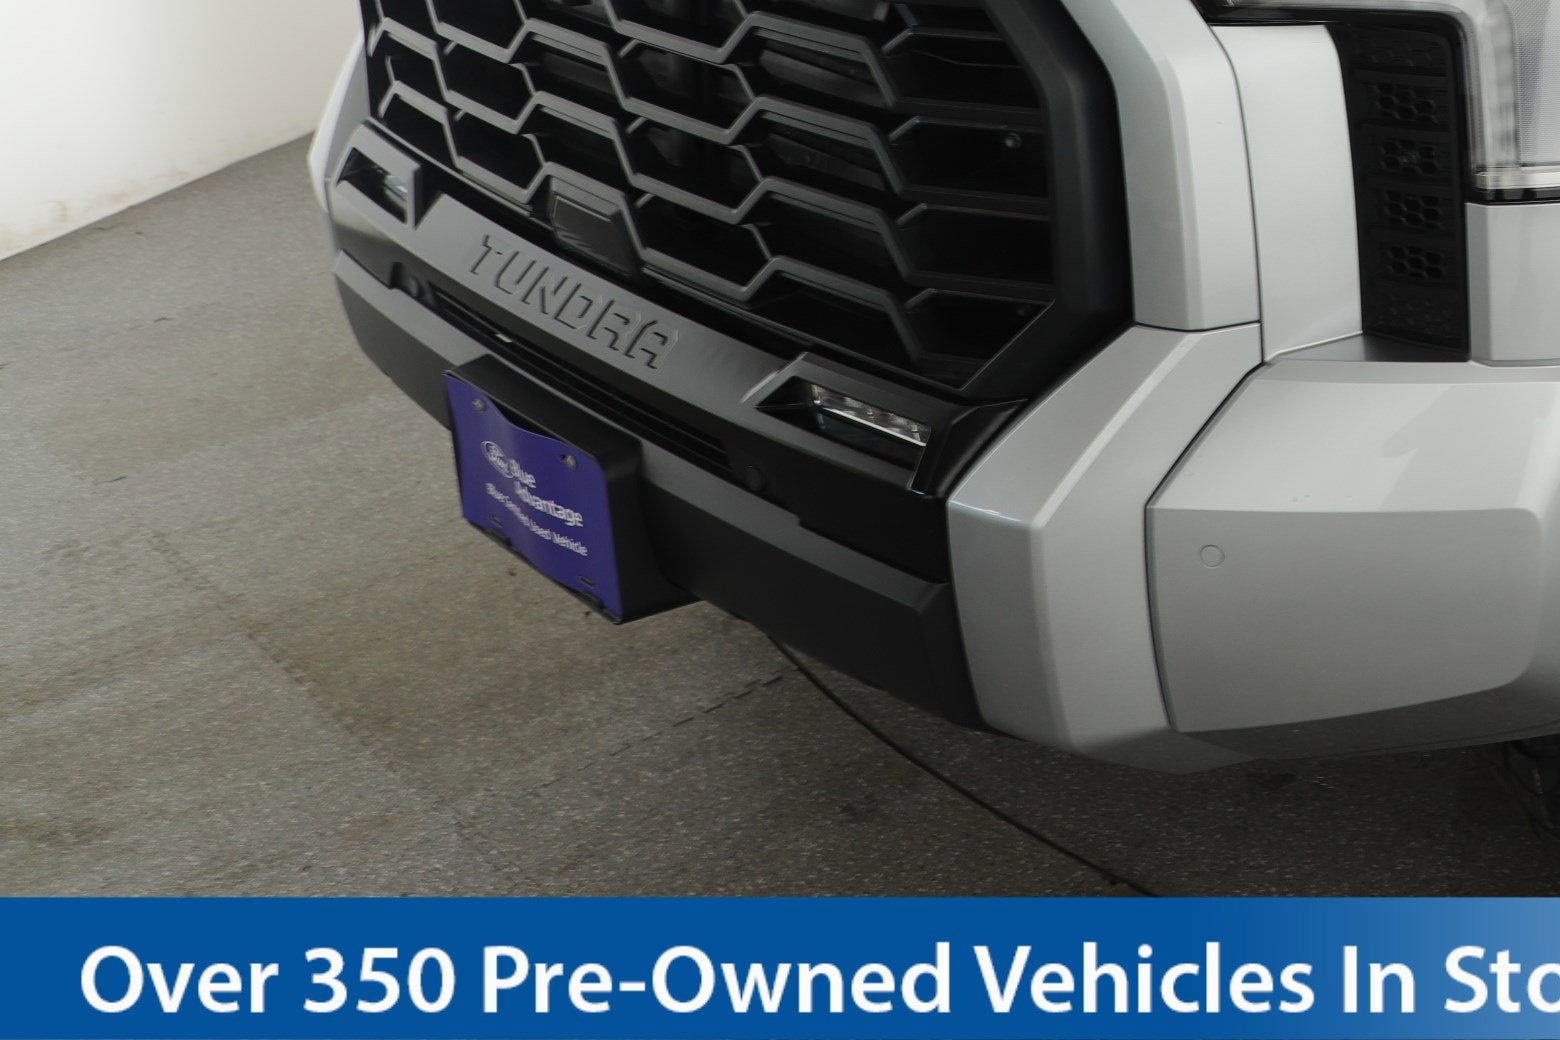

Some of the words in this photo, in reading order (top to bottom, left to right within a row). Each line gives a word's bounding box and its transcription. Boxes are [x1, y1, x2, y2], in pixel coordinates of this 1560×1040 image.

[468, 234, 679, 369] TUNDRA
[508, 458, 537, 489] Blue
[513, 480, 584, 527] Advantage
